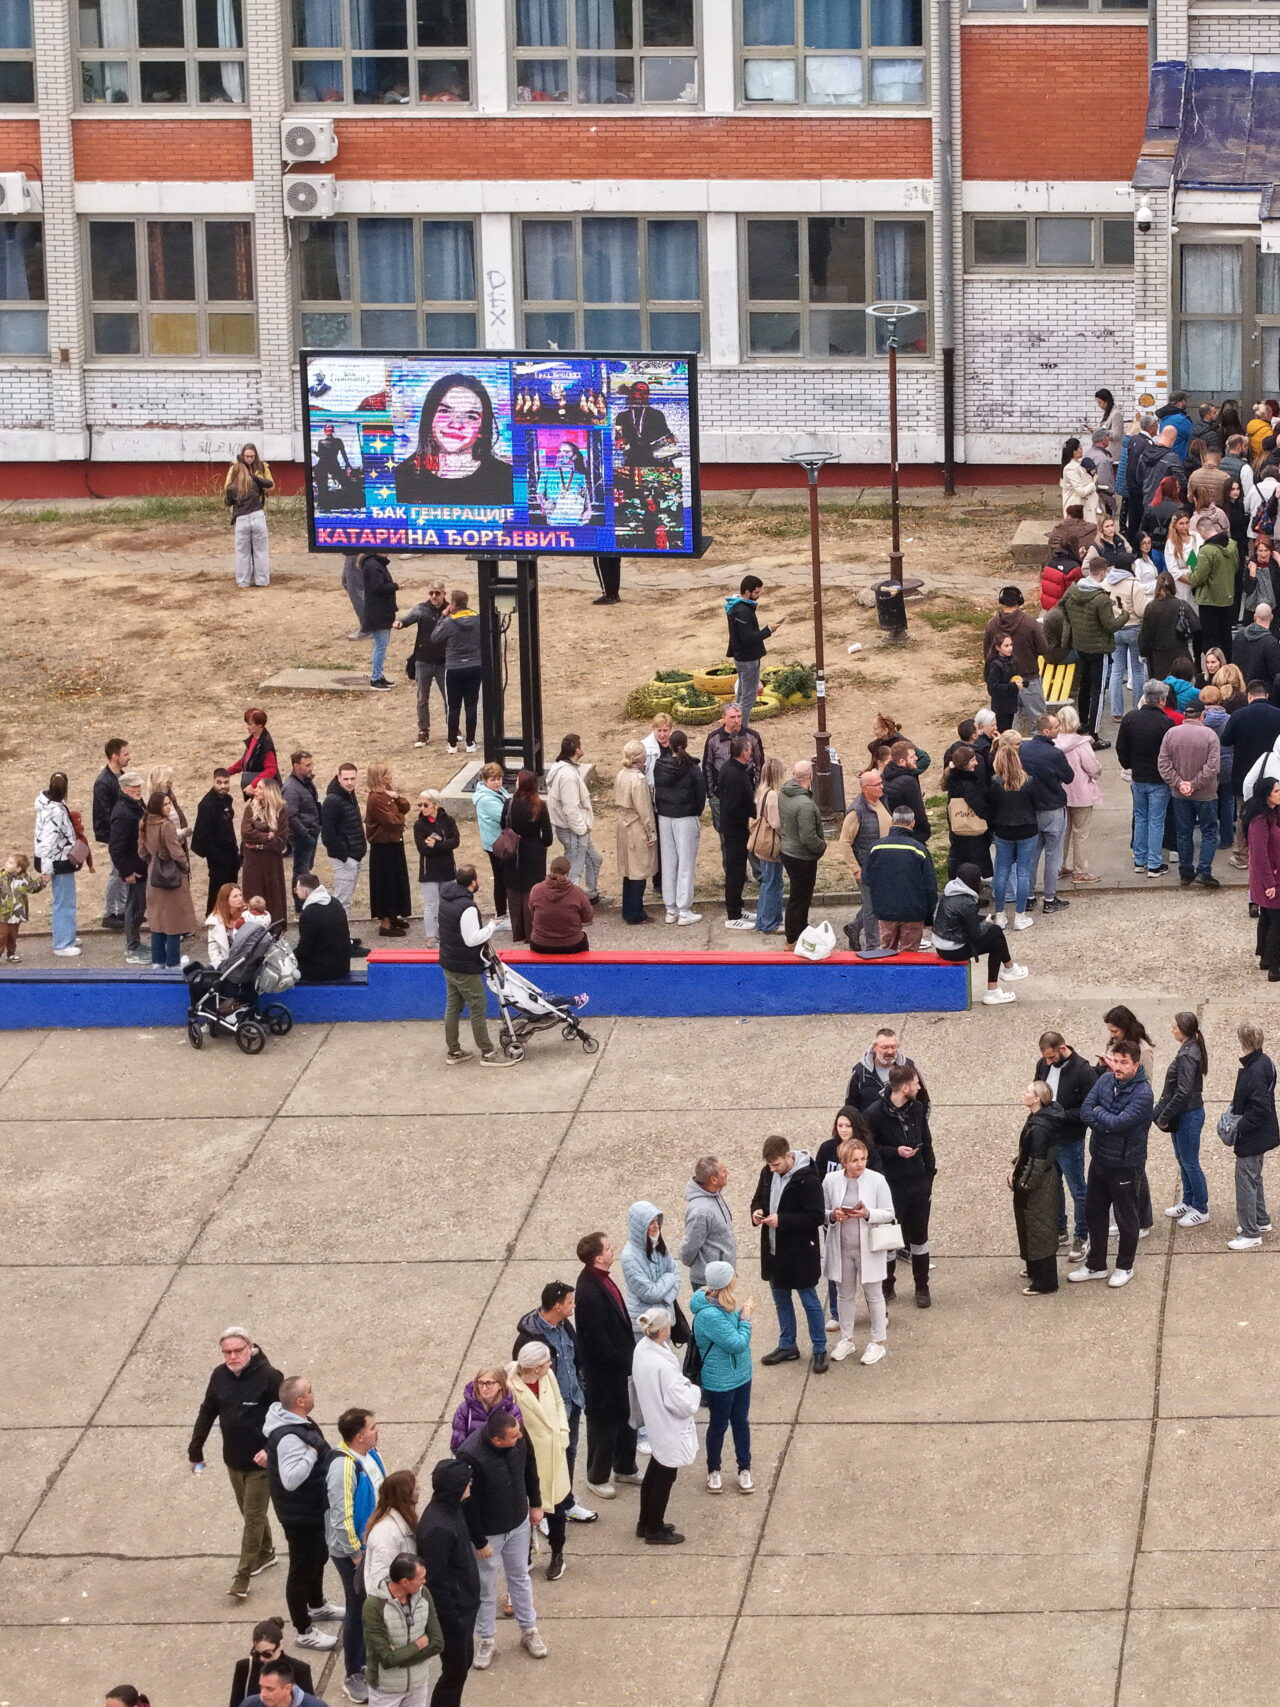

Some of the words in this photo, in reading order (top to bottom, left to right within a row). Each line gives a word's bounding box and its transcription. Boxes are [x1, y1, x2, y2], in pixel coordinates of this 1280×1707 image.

[370, 506, 407, 519] ЂАК
[410, 507, 515, 523] ГЕНЕРАЦИЈЕ
[318, 528, 440, 546] КАТАРИНА
[444, 529, 576, 548] ЂОРЂЕВИЋ
